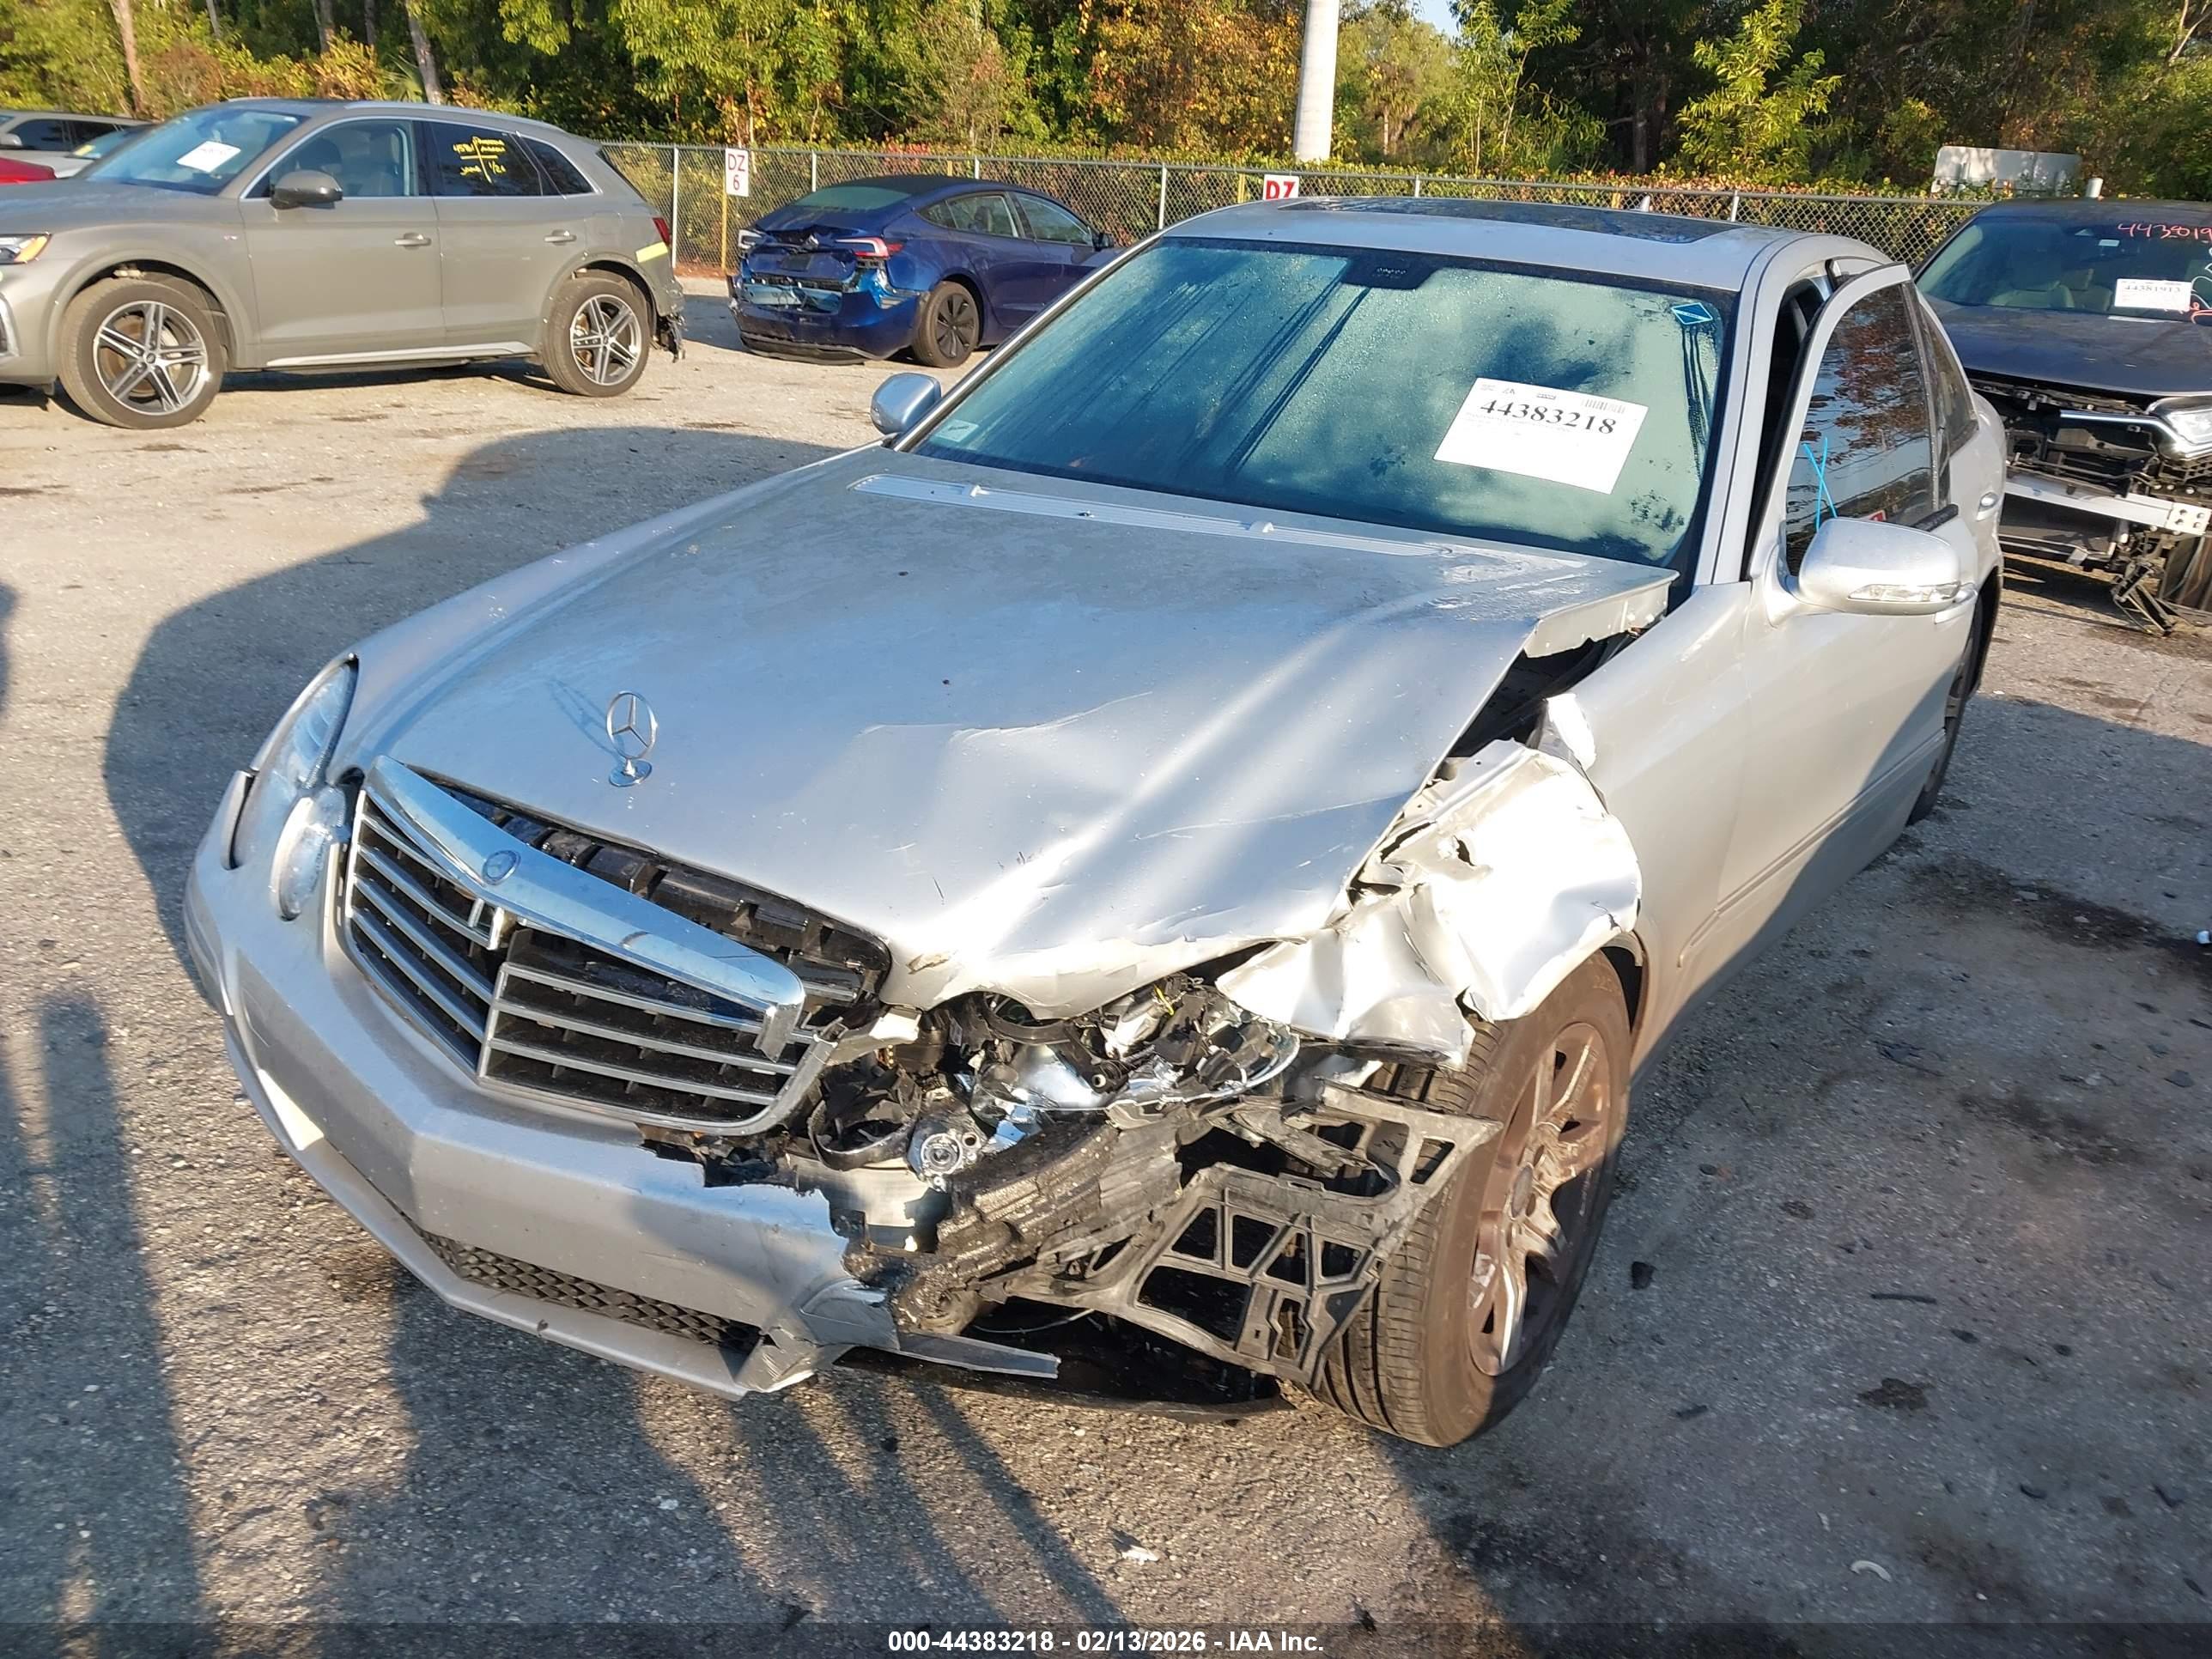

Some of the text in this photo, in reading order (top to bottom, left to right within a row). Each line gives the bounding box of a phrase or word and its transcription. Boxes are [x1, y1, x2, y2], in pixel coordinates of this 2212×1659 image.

[728, 153, 745, 172] DZ
[732, 174, 740, 191] 6
[1480, 399, 1617, 434] 44383218
